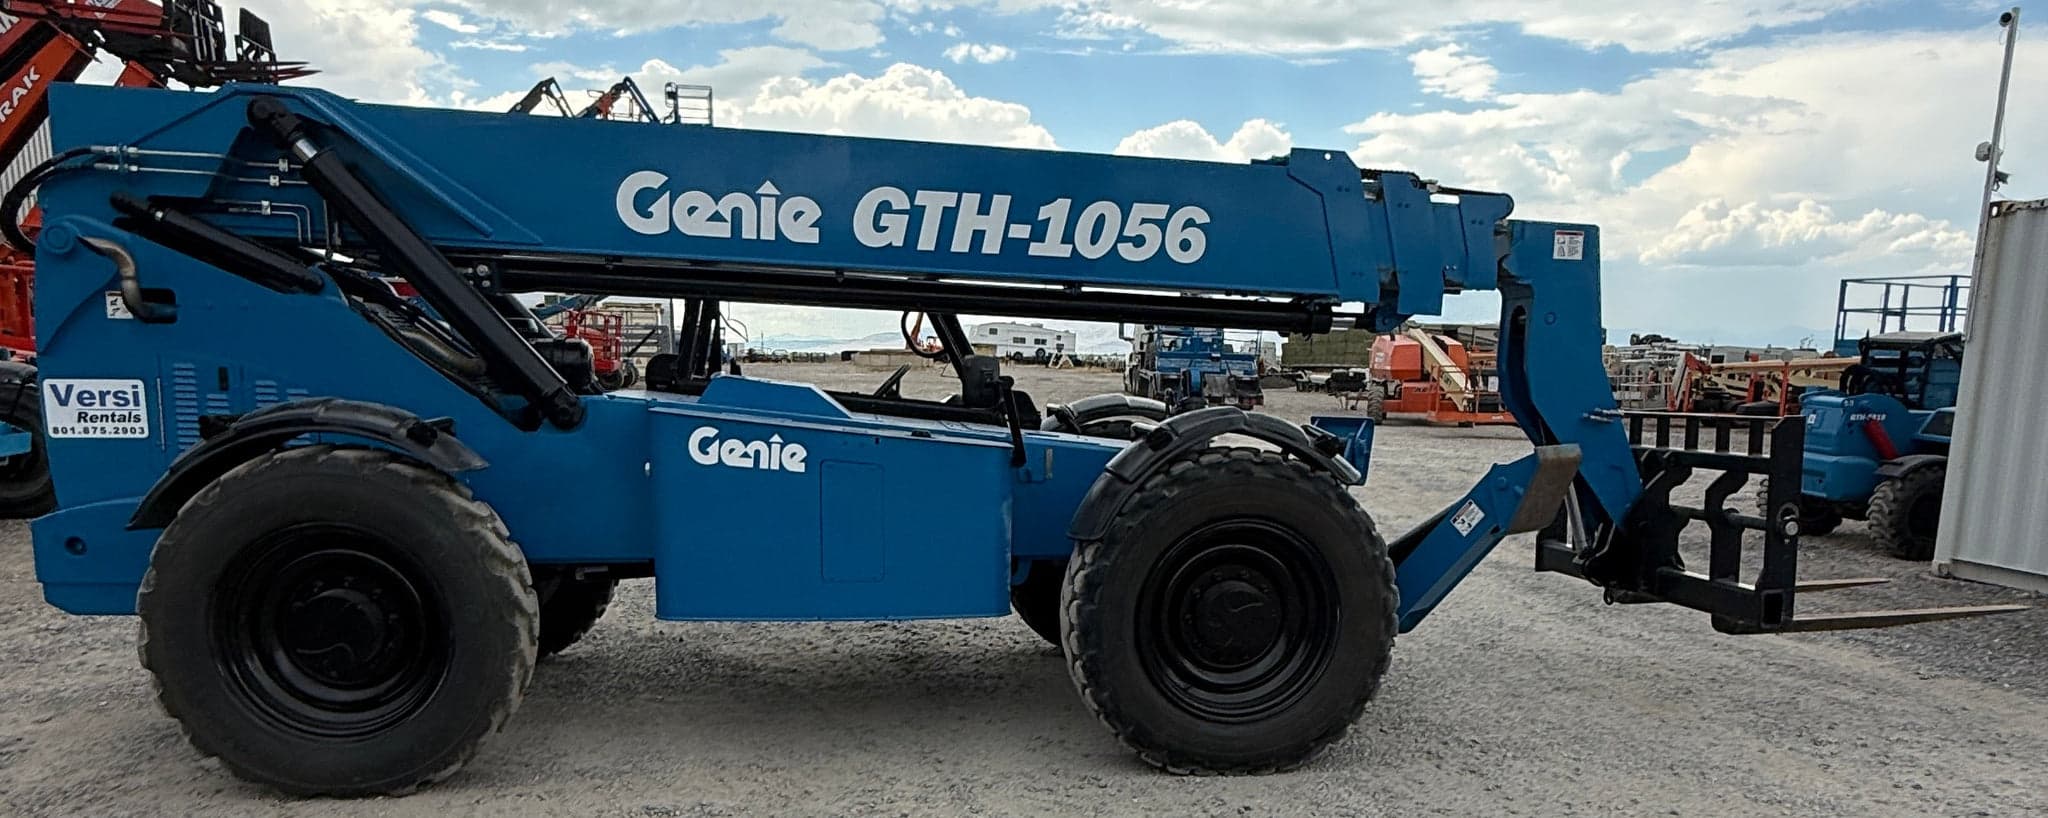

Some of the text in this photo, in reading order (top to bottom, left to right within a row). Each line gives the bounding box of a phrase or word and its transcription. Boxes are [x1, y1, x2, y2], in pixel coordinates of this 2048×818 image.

[616, 170, 1211, 264] Genie GTH-1056
[49, 384, 141, 407] Versi
[77, 411, 142, 424] Rentals
[52, 426, 145, 435] 801.875.2903
[687, 426, 808, 473] Genie
